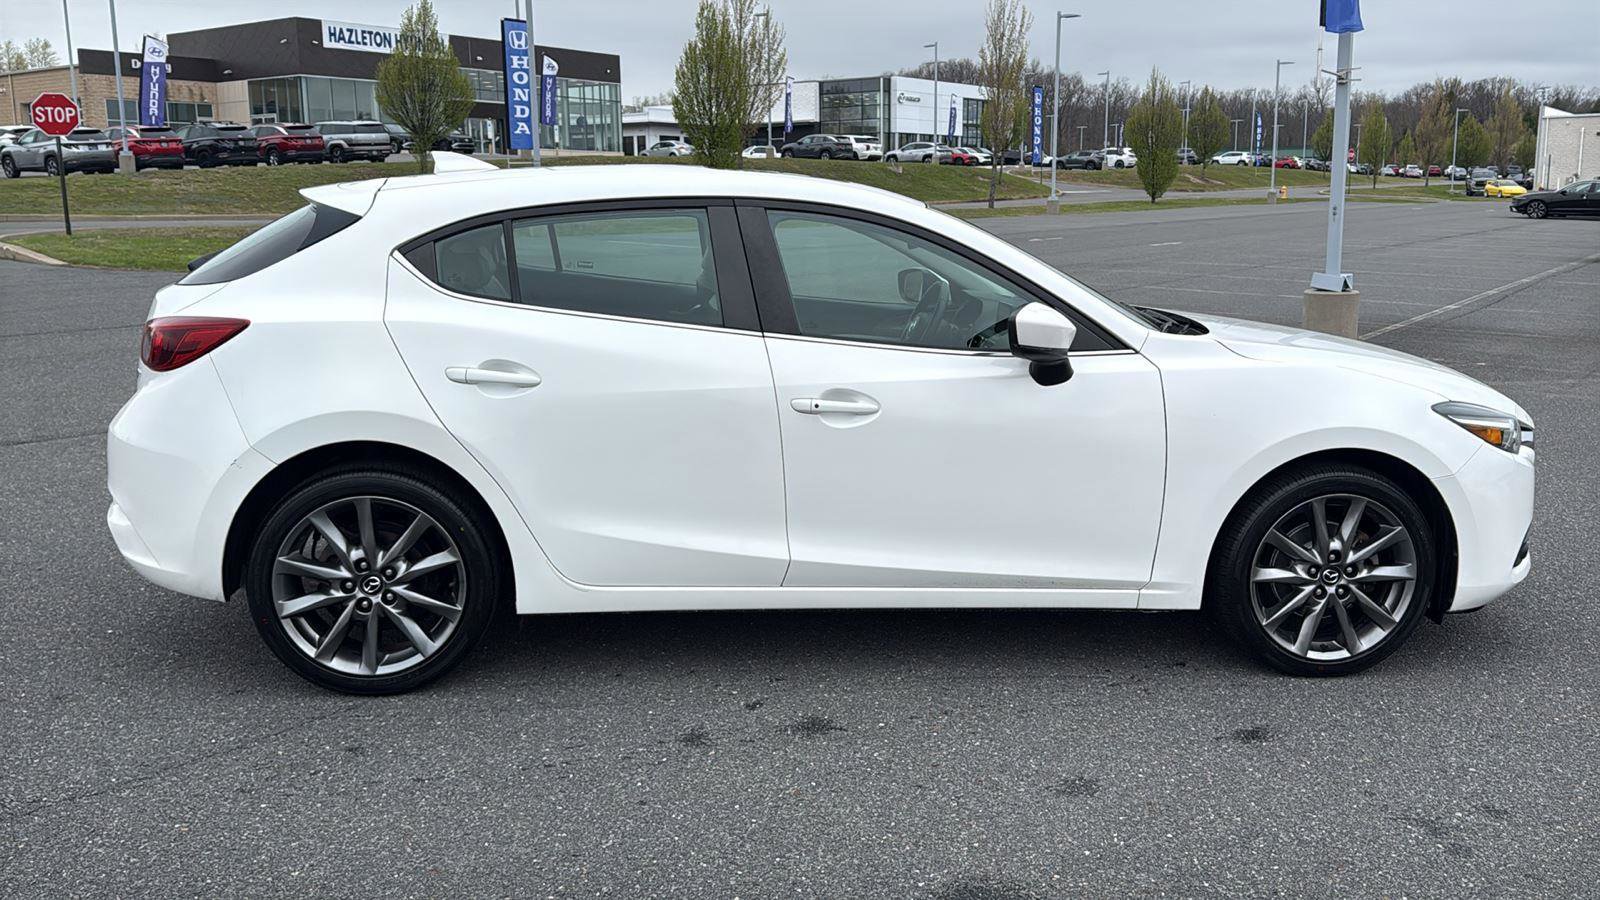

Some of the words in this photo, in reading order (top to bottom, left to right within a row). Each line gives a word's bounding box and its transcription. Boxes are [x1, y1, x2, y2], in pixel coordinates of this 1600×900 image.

[328, 26, 392, 48] HAZLETON
[35, 106, 76, 123] STOP
[150, 65, 160, 124] HYUNDAI
[510, 55, 530, 134] HONDA
[1034, 107, 1042, 154] HONDA
